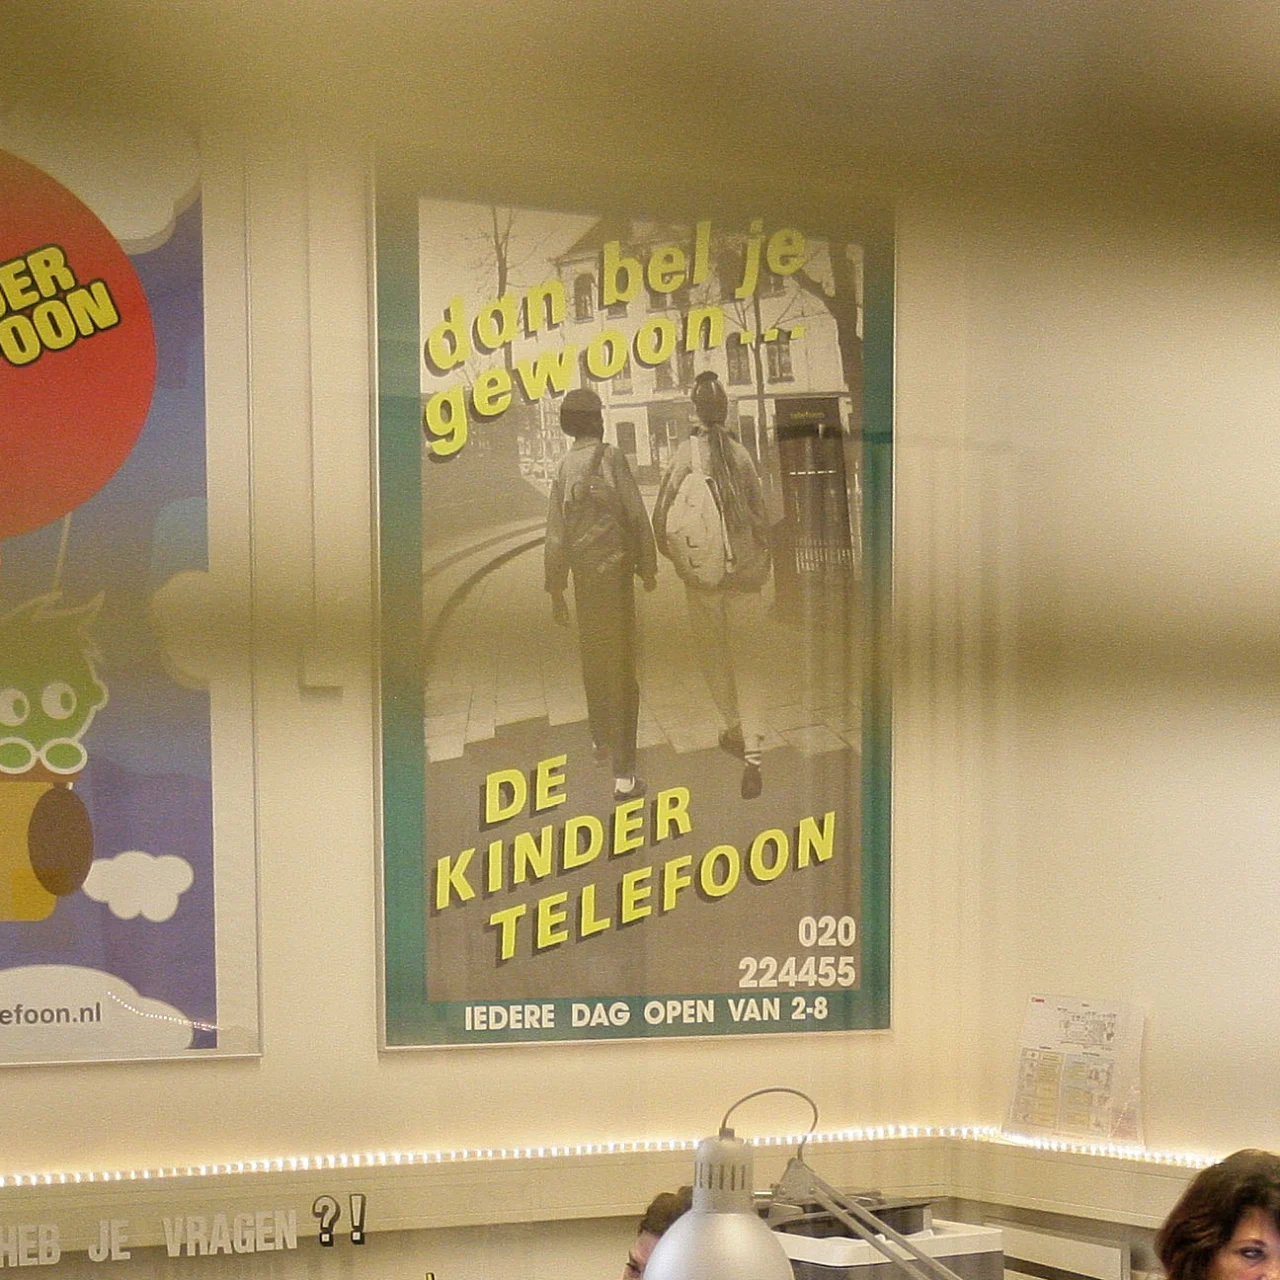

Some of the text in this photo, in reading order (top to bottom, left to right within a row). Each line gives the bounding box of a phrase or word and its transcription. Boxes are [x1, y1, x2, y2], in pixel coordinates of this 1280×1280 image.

[426, 217, 805, 371] dan bel je
[484, 752, 568, 826] DE
[434, 785, 692, 911] KINDER
[489, 810, 836, 962] TELEFOON
[797, 915, 857, 948] 020
[737, 955, 857, 989] 224455
[464, 995, 829, 1032] IEDERE DAG OPEN VAN 2-8
[88, 1217, 131, 1263] JE
[162, 1209, 298, 1258] VRAGEN
